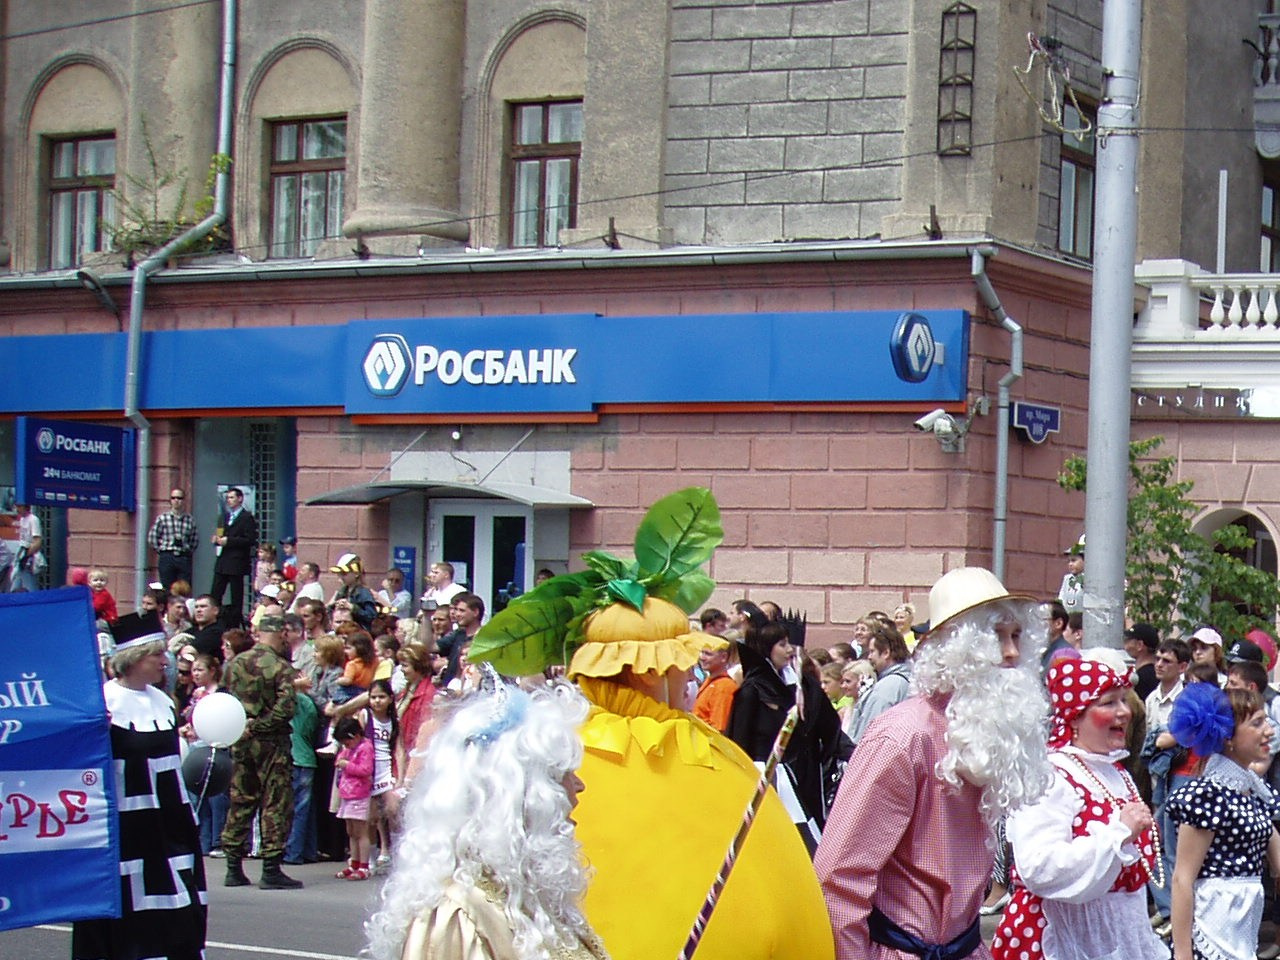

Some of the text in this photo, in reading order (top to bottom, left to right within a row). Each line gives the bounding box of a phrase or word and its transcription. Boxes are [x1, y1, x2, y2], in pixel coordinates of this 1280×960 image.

[414, 345, 577, 385] РОСБАНК
[1137, 395, 1246, 411] СТУДИЯ
[56, 434, 111, 455] РОСБАНК
